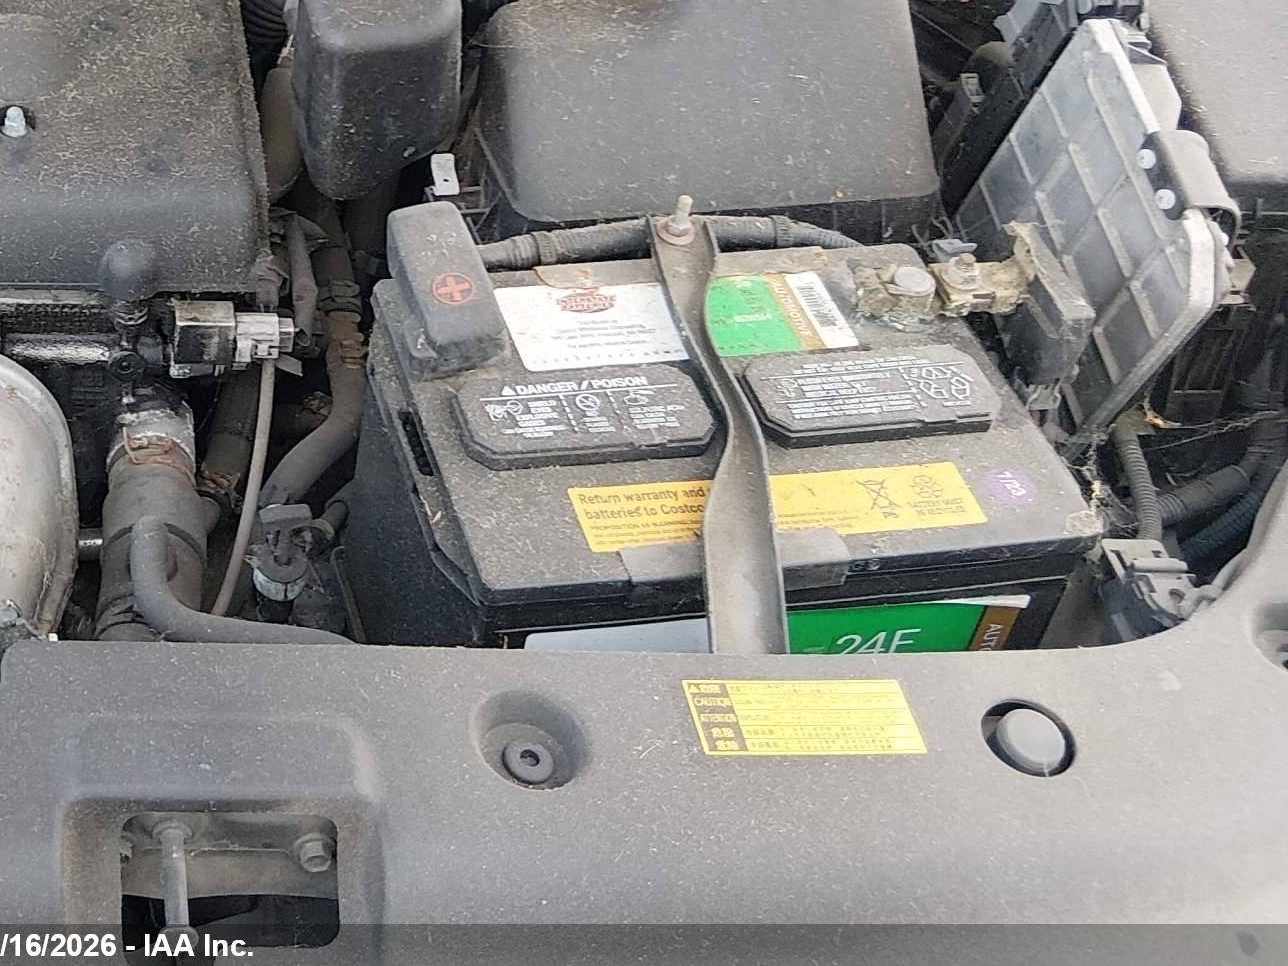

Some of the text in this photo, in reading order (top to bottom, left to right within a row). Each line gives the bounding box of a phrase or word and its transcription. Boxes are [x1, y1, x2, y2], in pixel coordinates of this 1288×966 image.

[515, 381, 579, 395] DANGER
[591, 376, 649, 389] POISON
[578, 485, 706, 505] Return warranty and
[584, 502, 704, 520] batteries to Costco
